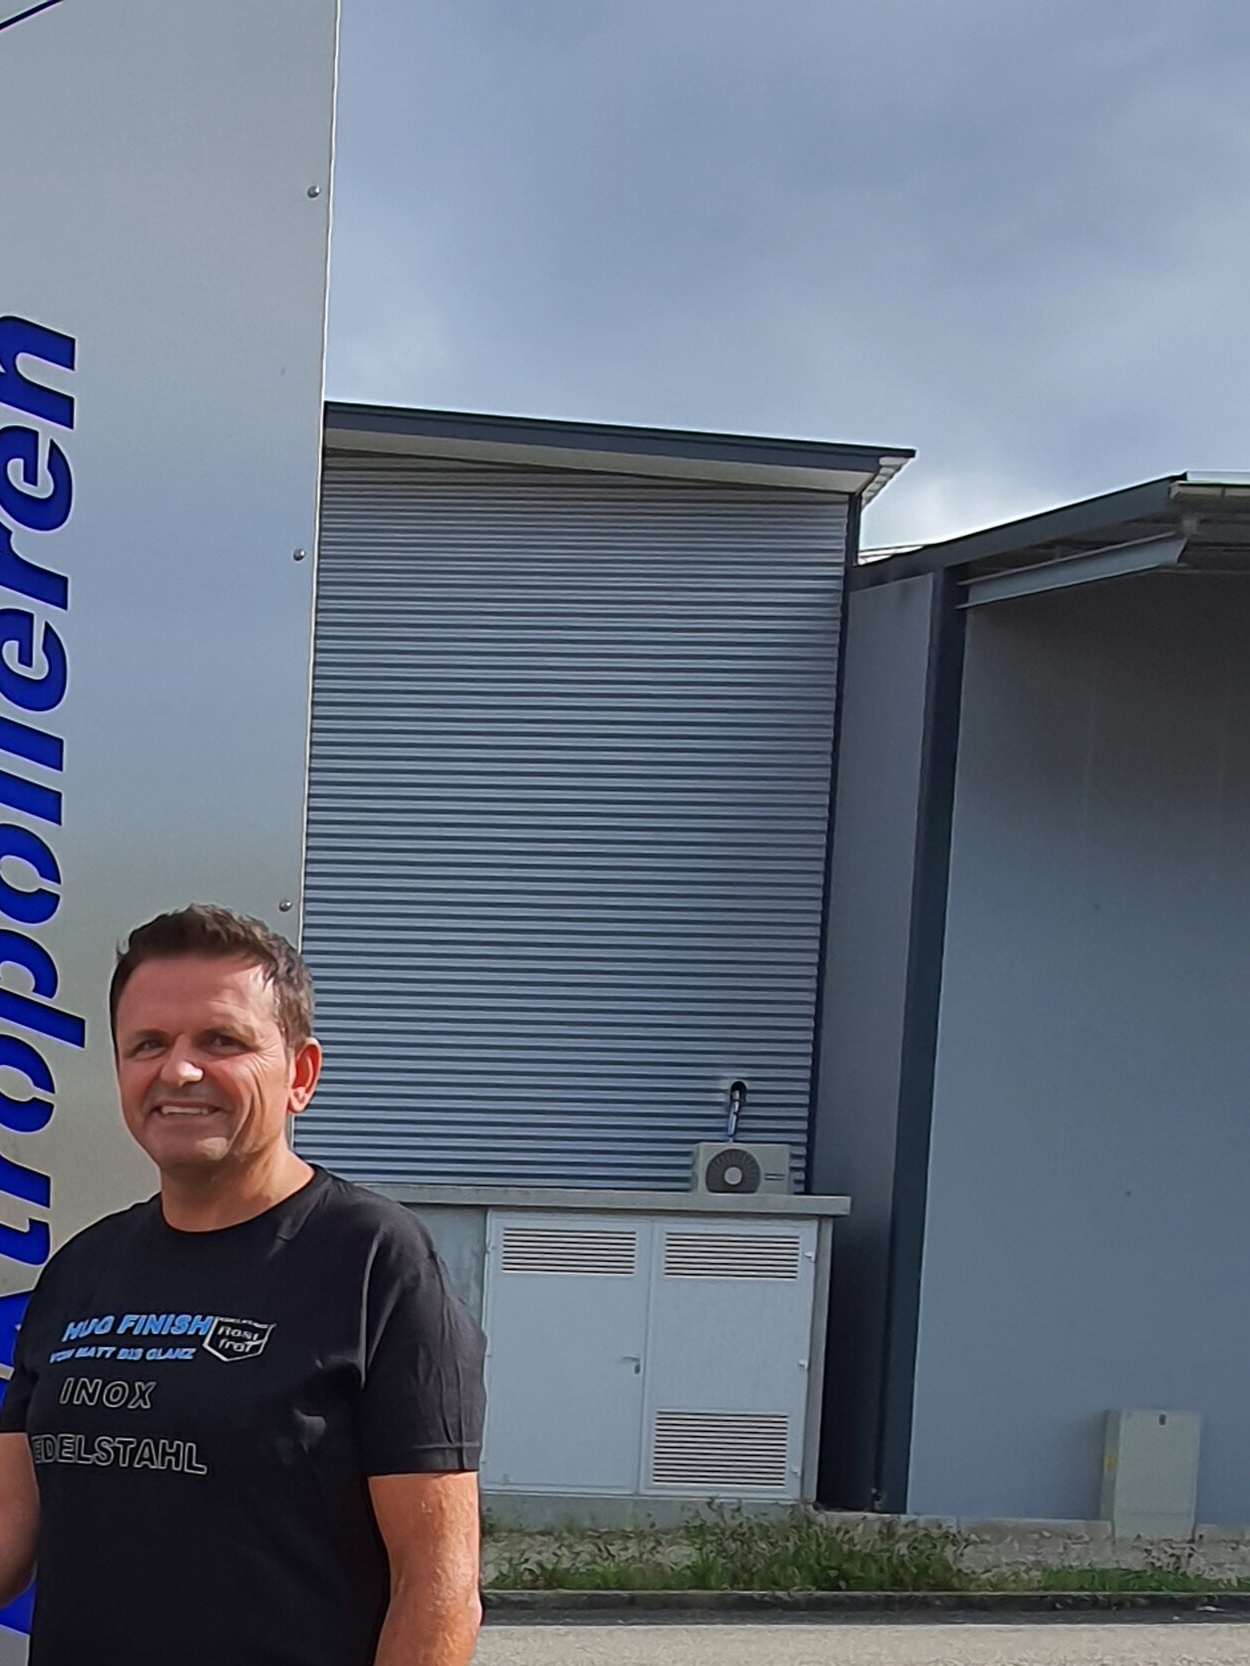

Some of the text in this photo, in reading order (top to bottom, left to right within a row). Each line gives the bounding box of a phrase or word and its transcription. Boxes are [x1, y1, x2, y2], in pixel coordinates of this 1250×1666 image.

[61, 1315, 115, 1343] HUG
[116, 1313, 214, 1336] FINISH
[74, 1346, 117, 1358] MATT
[144, 1347, 197, 1361] GLANZ
[59, 1376, 158, 1409] INOX
[31, 1433, 208, 1476] EDELSTAHL
